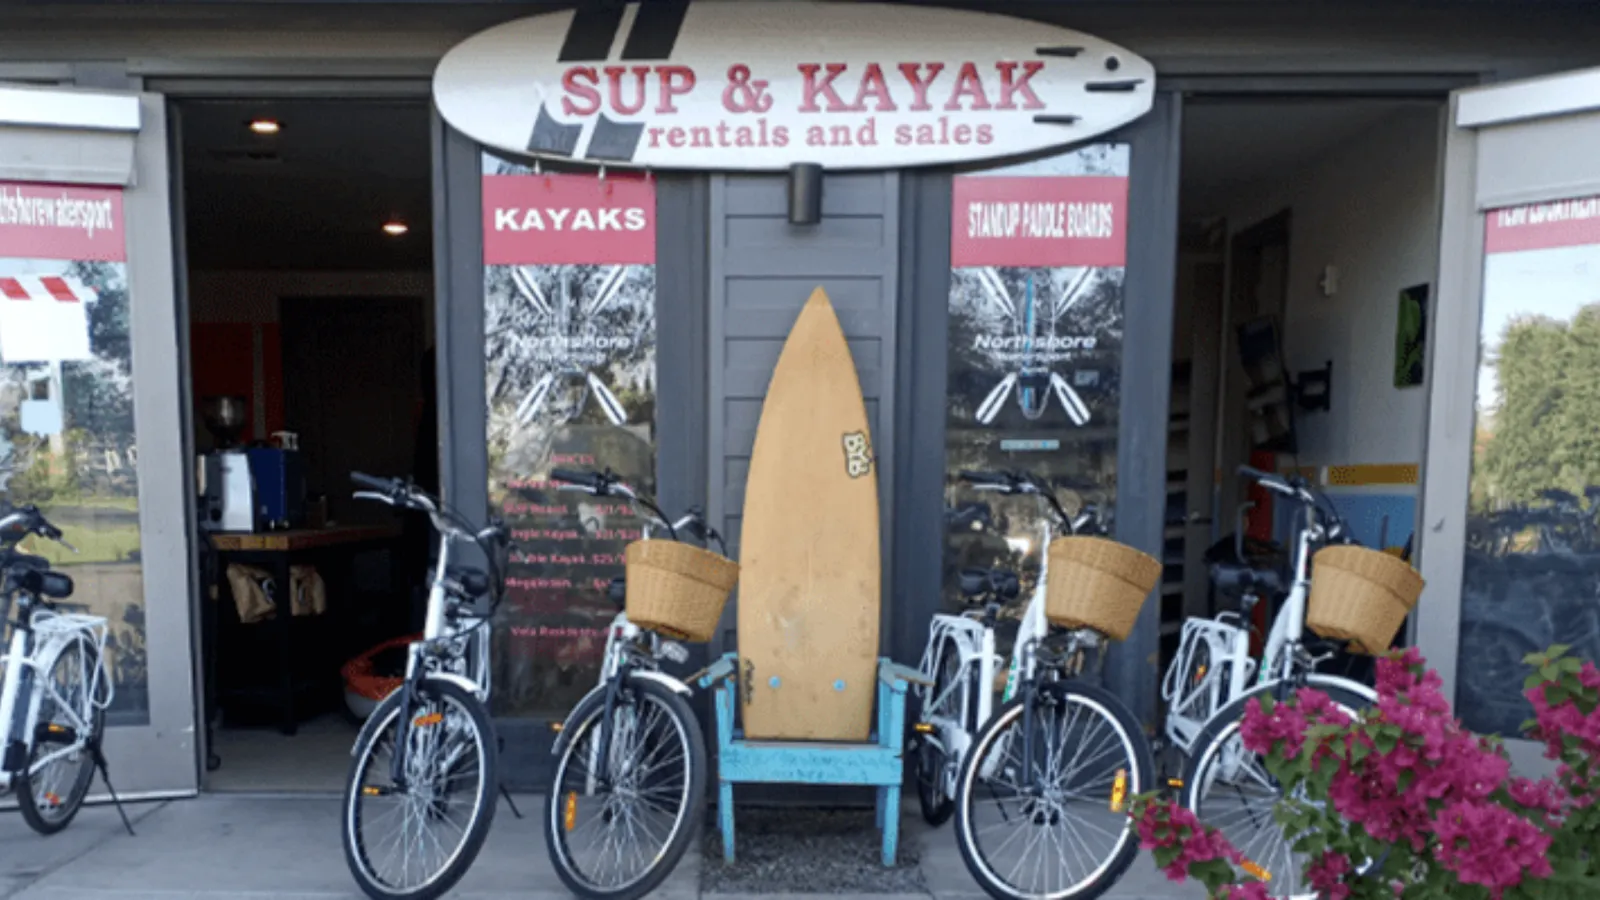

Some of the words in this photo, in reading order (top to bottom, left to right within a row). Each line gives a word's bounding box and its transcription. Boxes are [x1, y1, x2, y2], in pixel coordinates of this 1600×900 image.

[561, 65, 697, 116] SUP
[721, 64, 774, 114] &
[797, 61, 1047, 113] KAYAK
[648, 119, 790, 149] rentals
[805, 116, 878, 147] and
[895, 116, 994, 146] sales
[494, 207, 646, 231] KAYAKS
[1021, 201, 1065, 239] PADDLE
[1067, 201, 1113, 239] BOARDS
[972, 333, 1097, 350] Northshore
